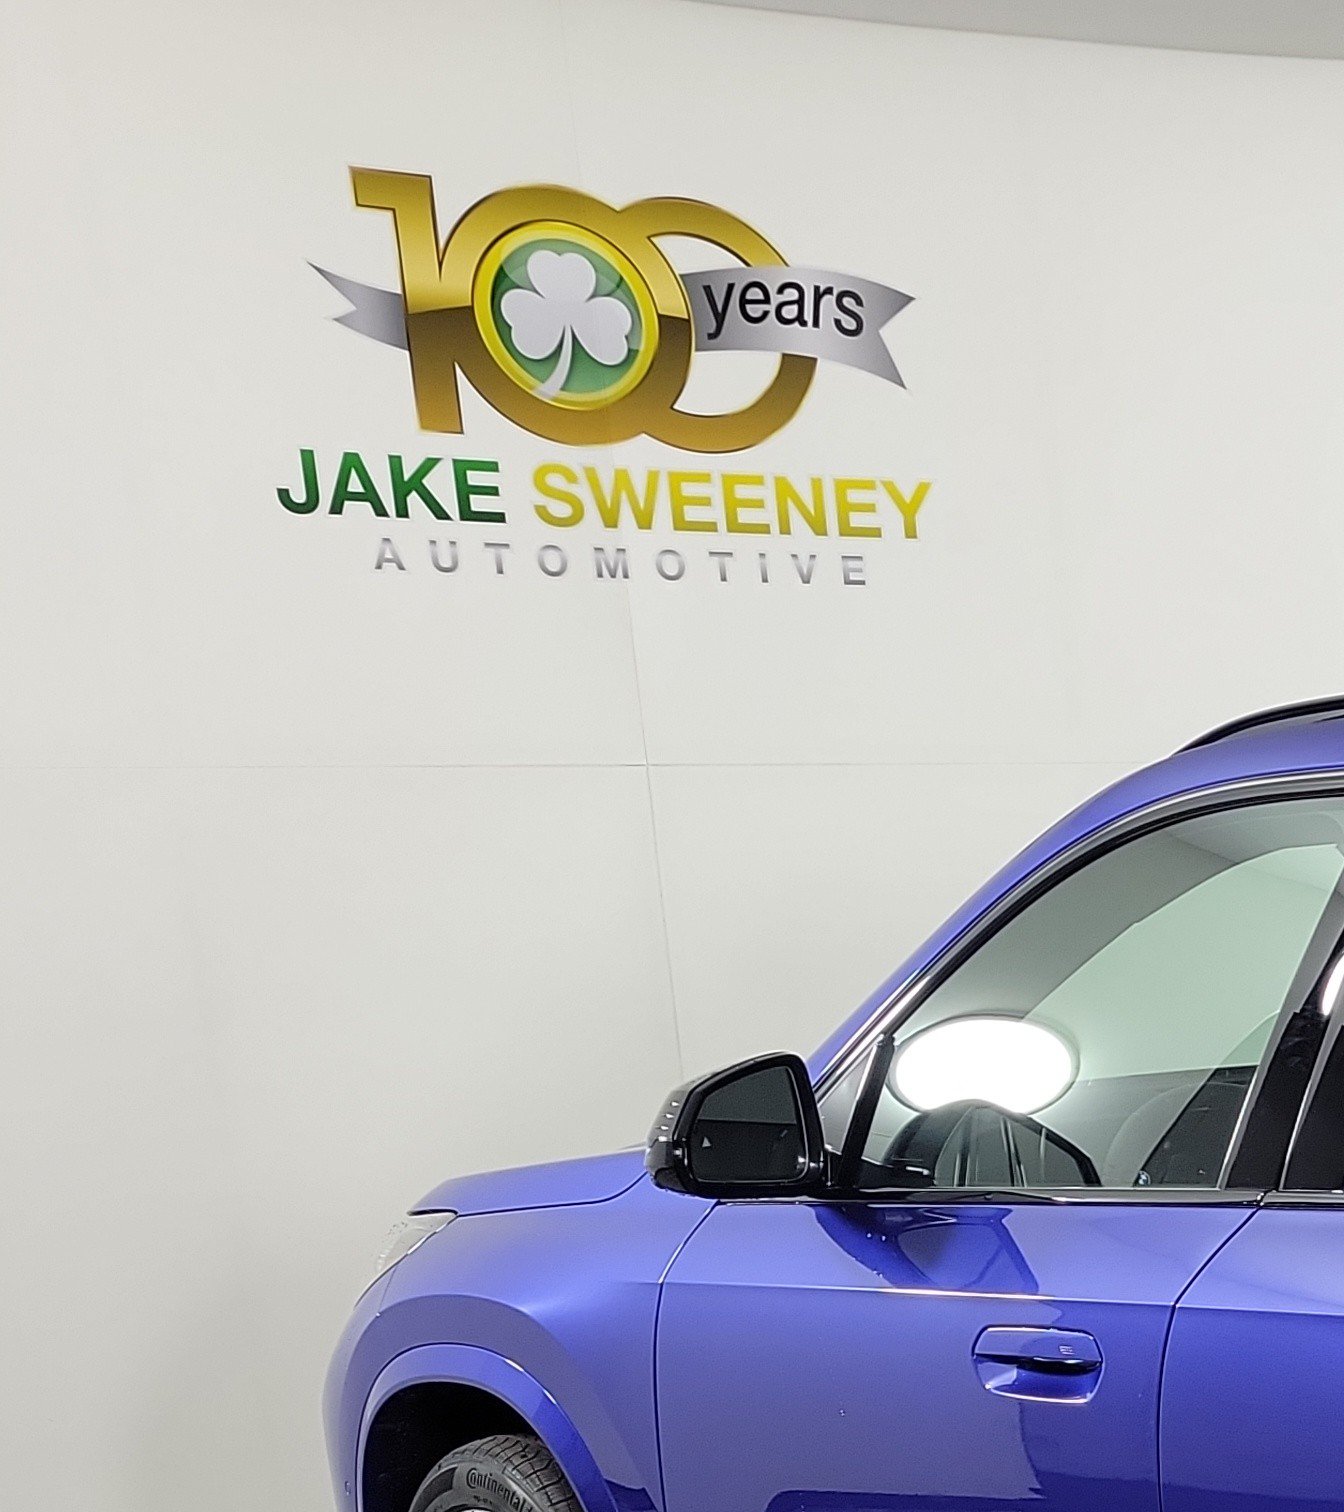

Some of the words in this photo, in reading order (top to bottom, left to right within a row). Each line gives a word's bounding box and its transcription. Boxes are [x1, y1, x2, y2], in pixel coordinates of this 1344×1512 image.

[702, 279, 866, 341] years
[276, 448, 507, 524] JAKE
[531, 461, 933, 541] SWEENEY
[374, 537, 866, 587] AUTOMOTIVE
